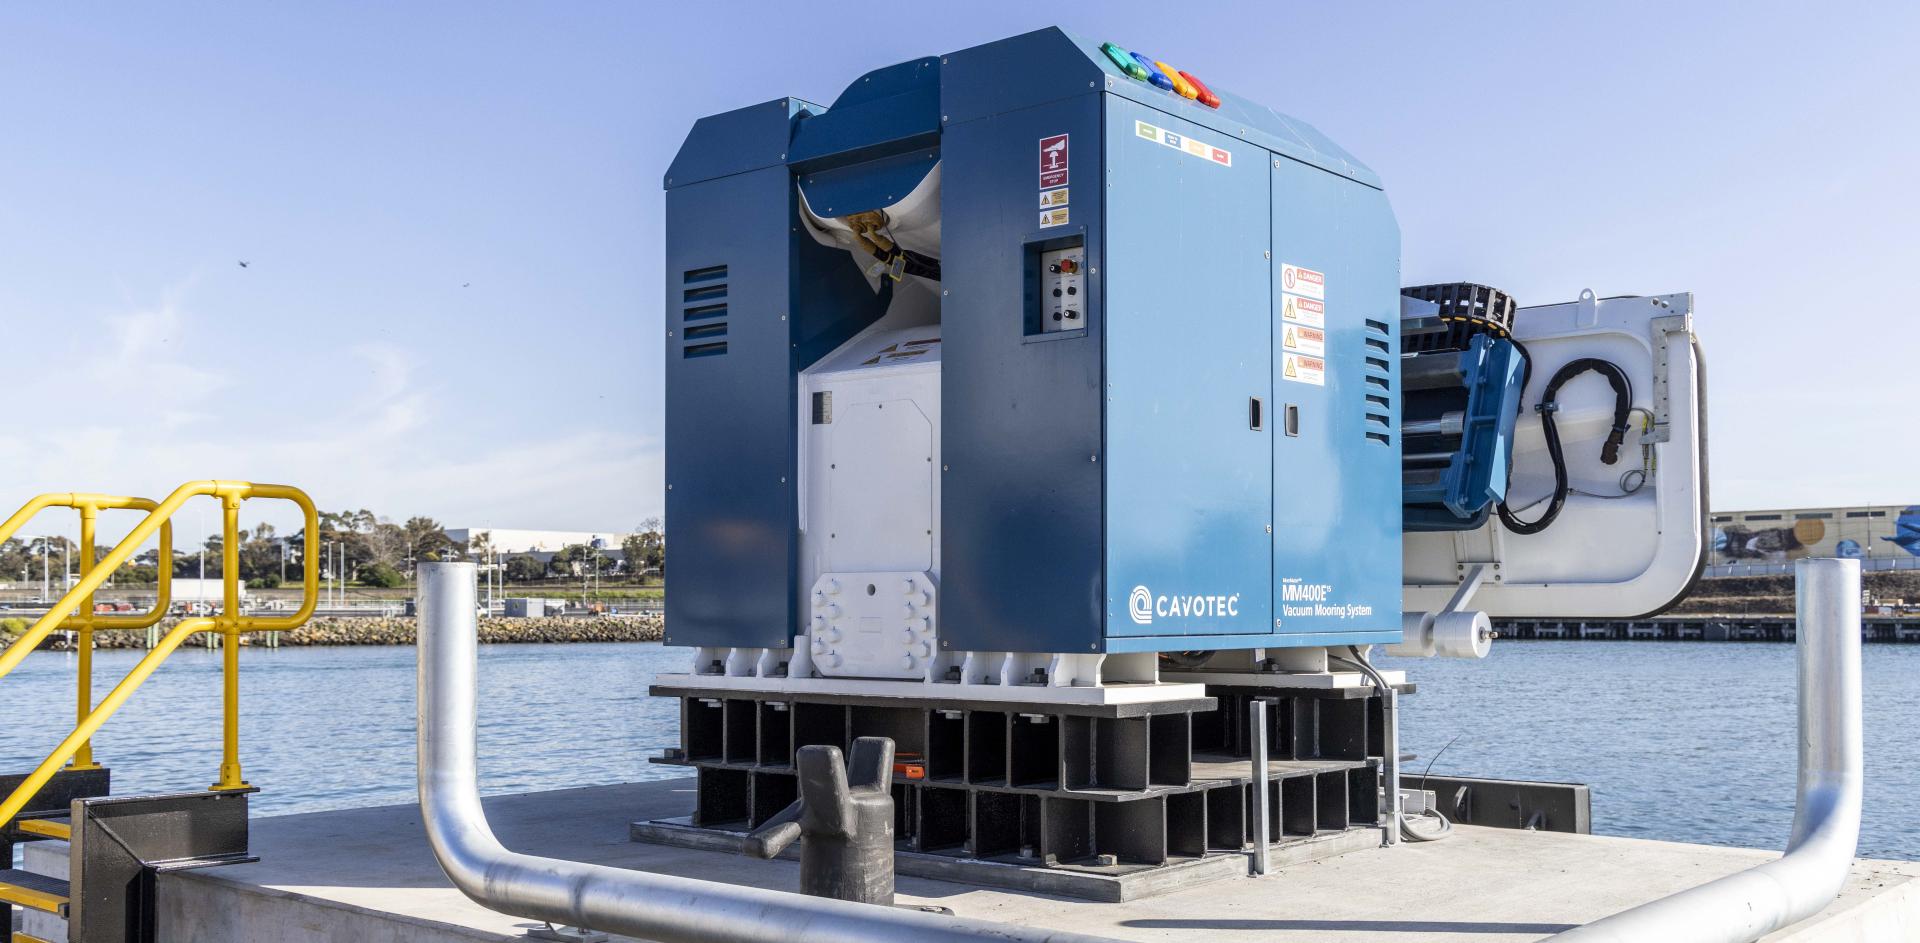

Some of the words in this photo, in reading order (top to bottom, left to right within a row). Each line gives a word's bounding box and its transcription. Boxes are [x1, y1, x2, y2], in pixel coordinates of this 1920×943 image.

[1303, 272, 1322, 283] DANGER
[1303, 301, 1322, 312] DANGER
[1303, 331, 1323, 341] WARNING
[1303, 359, 1323, 369] WARNING
[1156, 595, 1239, 617] CAVOTEC
[1282, 604, 1312, 616] Vacuum
[1315, 604, 1345, 618] Mooring
[1347, 604, 1371, 619] System
